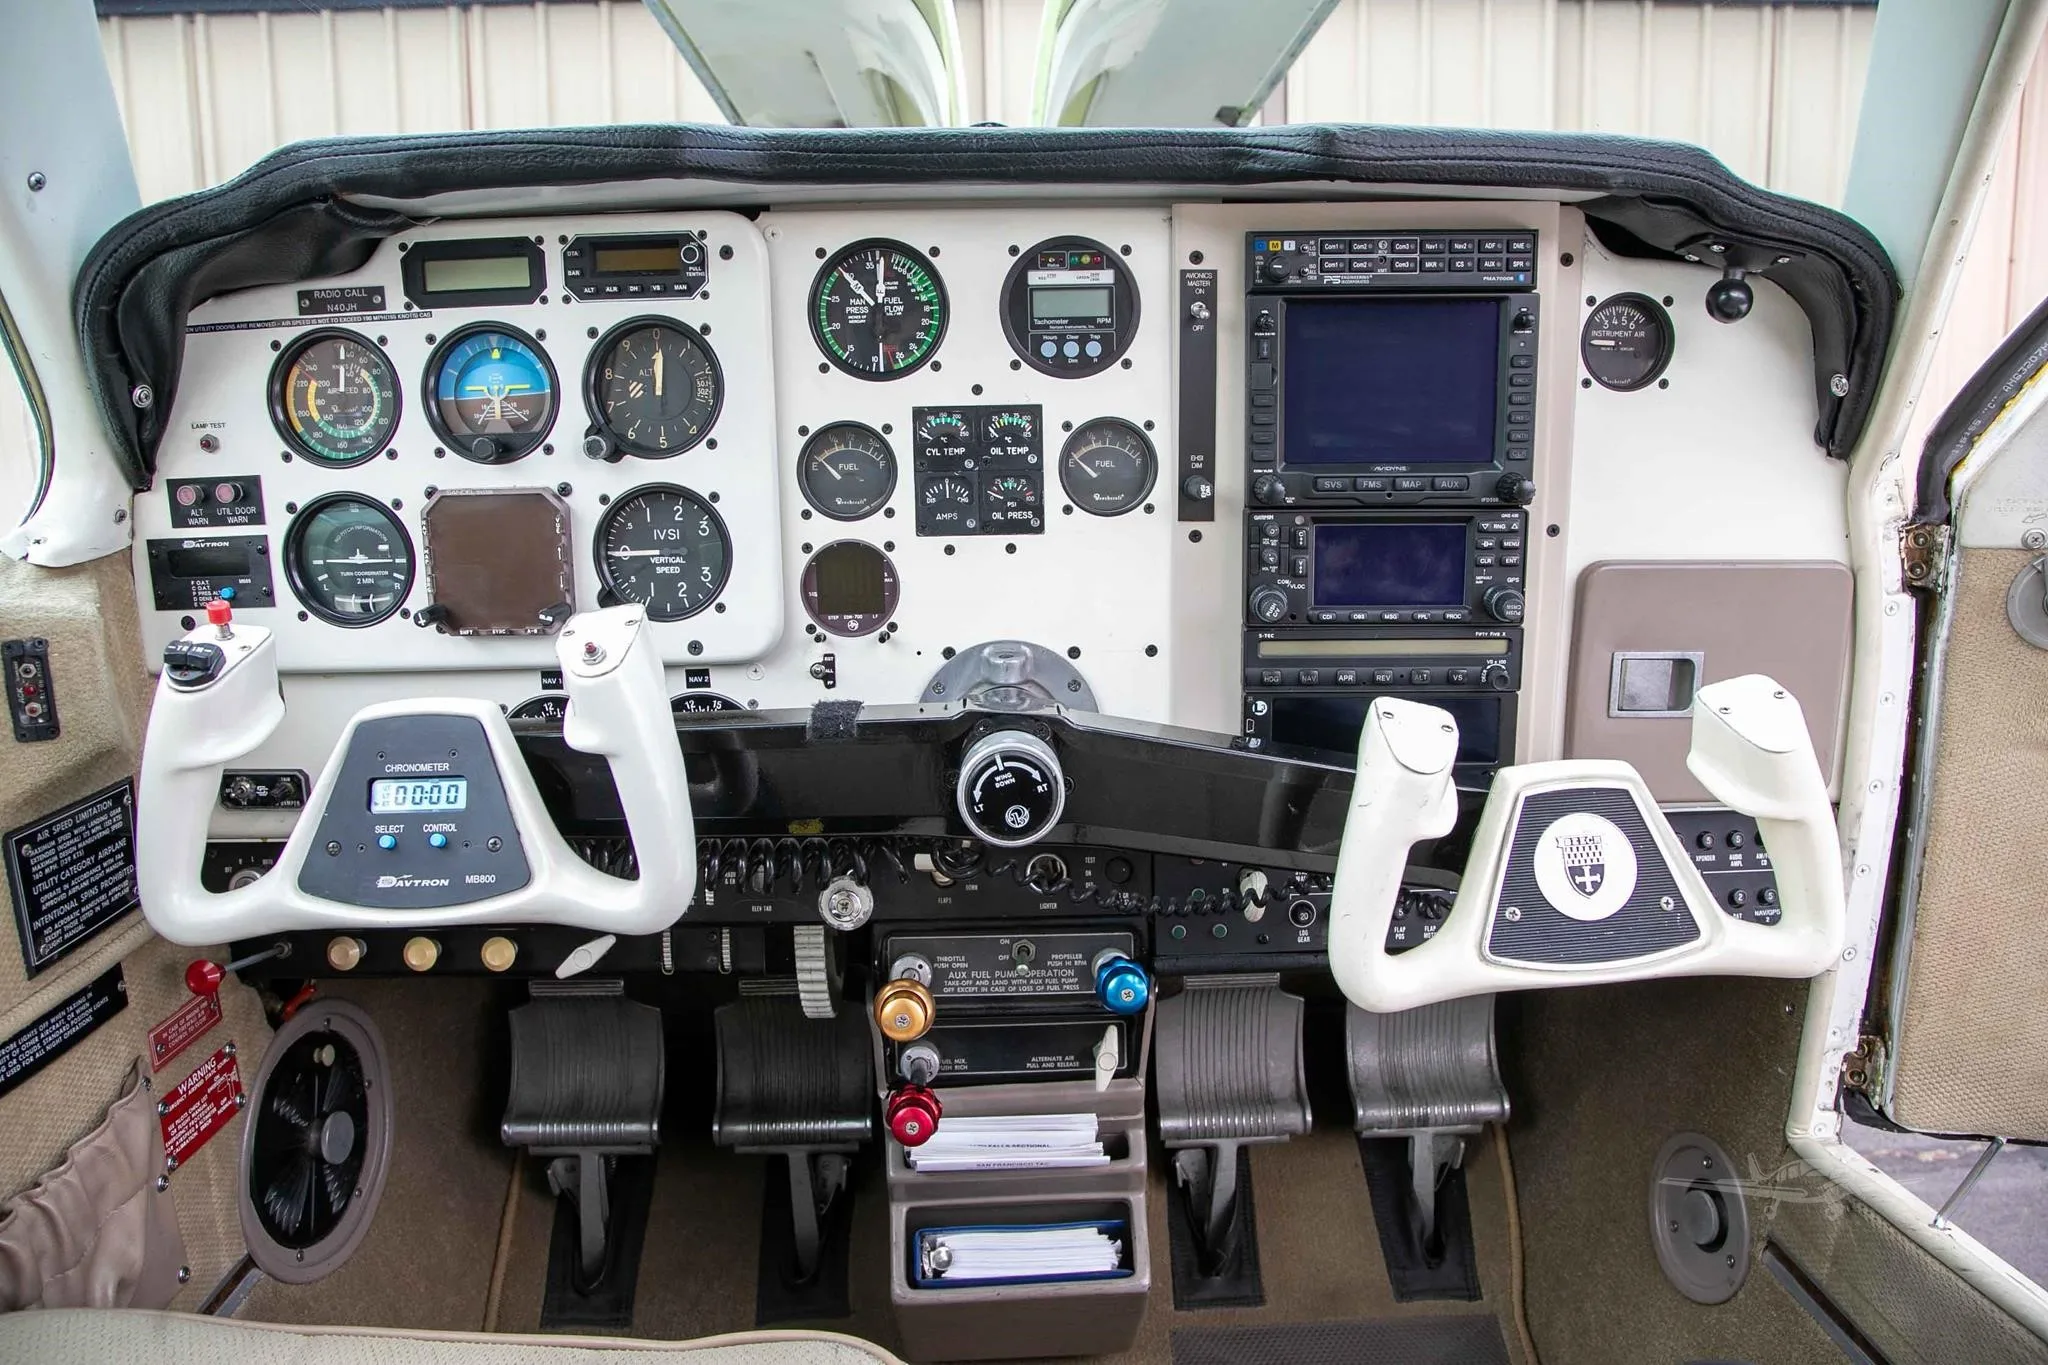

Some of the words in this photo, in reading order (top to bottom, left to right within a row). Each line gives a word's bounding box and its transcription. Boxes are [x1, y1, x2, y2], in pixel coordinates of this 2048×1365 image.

[314, 290, 341, 298] RADIO
[345, 289, 367, 297] CALL
[1603, 321, 1609, 329] 3
[1622, 317, 1627, 325] 5
[1630, 321, 1635, 329] 6
[653, 330, 660, 339] 0
[622, 340, 630, 351] 9
[628, 428, 635, 439] 6
[660, 437, 667, 448] 5
[926, 448, 940, 456] CYL
[812, 462, 818, 470] E
[1069, 459, 1075, 467] E
[674, 506, 683, 520] 2
[992, 512, 1004, 520] OIL
[1008, 511, 1033, 519] PRESS
[699, 521, 709, 536] 3
[654, 529, 680, 540] IVSI
[701, 567, 711, 581] 3
[678, 582, 687, 596] 2
[544, 702, 553, 711] 12
[685, 700, 694, 709] 12
[385, 763, 449, 772] CHRONOMETER
[1037, 783, 1048, 793] RT
[974, 804, 984, 813] LT
[37, 830, 50, 842] AIR
[52, 819, 73, 834] SPEED
[76, 799, 112, 823] LIMITATION
[423, 824, 457, 832] CONTROL
[33, 875, 58, 894] UTILITY
[60, 855, 95, 879] CATEGORY
[98, 838, 126, 859] AIRPLANE
[376, 875, 449, 887] DAVTRON
[466, 875, 495, 883] MB800
[33, 899, 78, 930] INTENTIONAL
[81, 886, 98, 902] SPINS
[100, 865, 133, 890] PROHIBITED
[1025, 969, 1074, 977] OPERATION
[64, 1015, 92, 1039] OPERATIONS
[43, 1024, 70, 1045] STANDARD
[178, 1057, 216, 1095] WARNING
